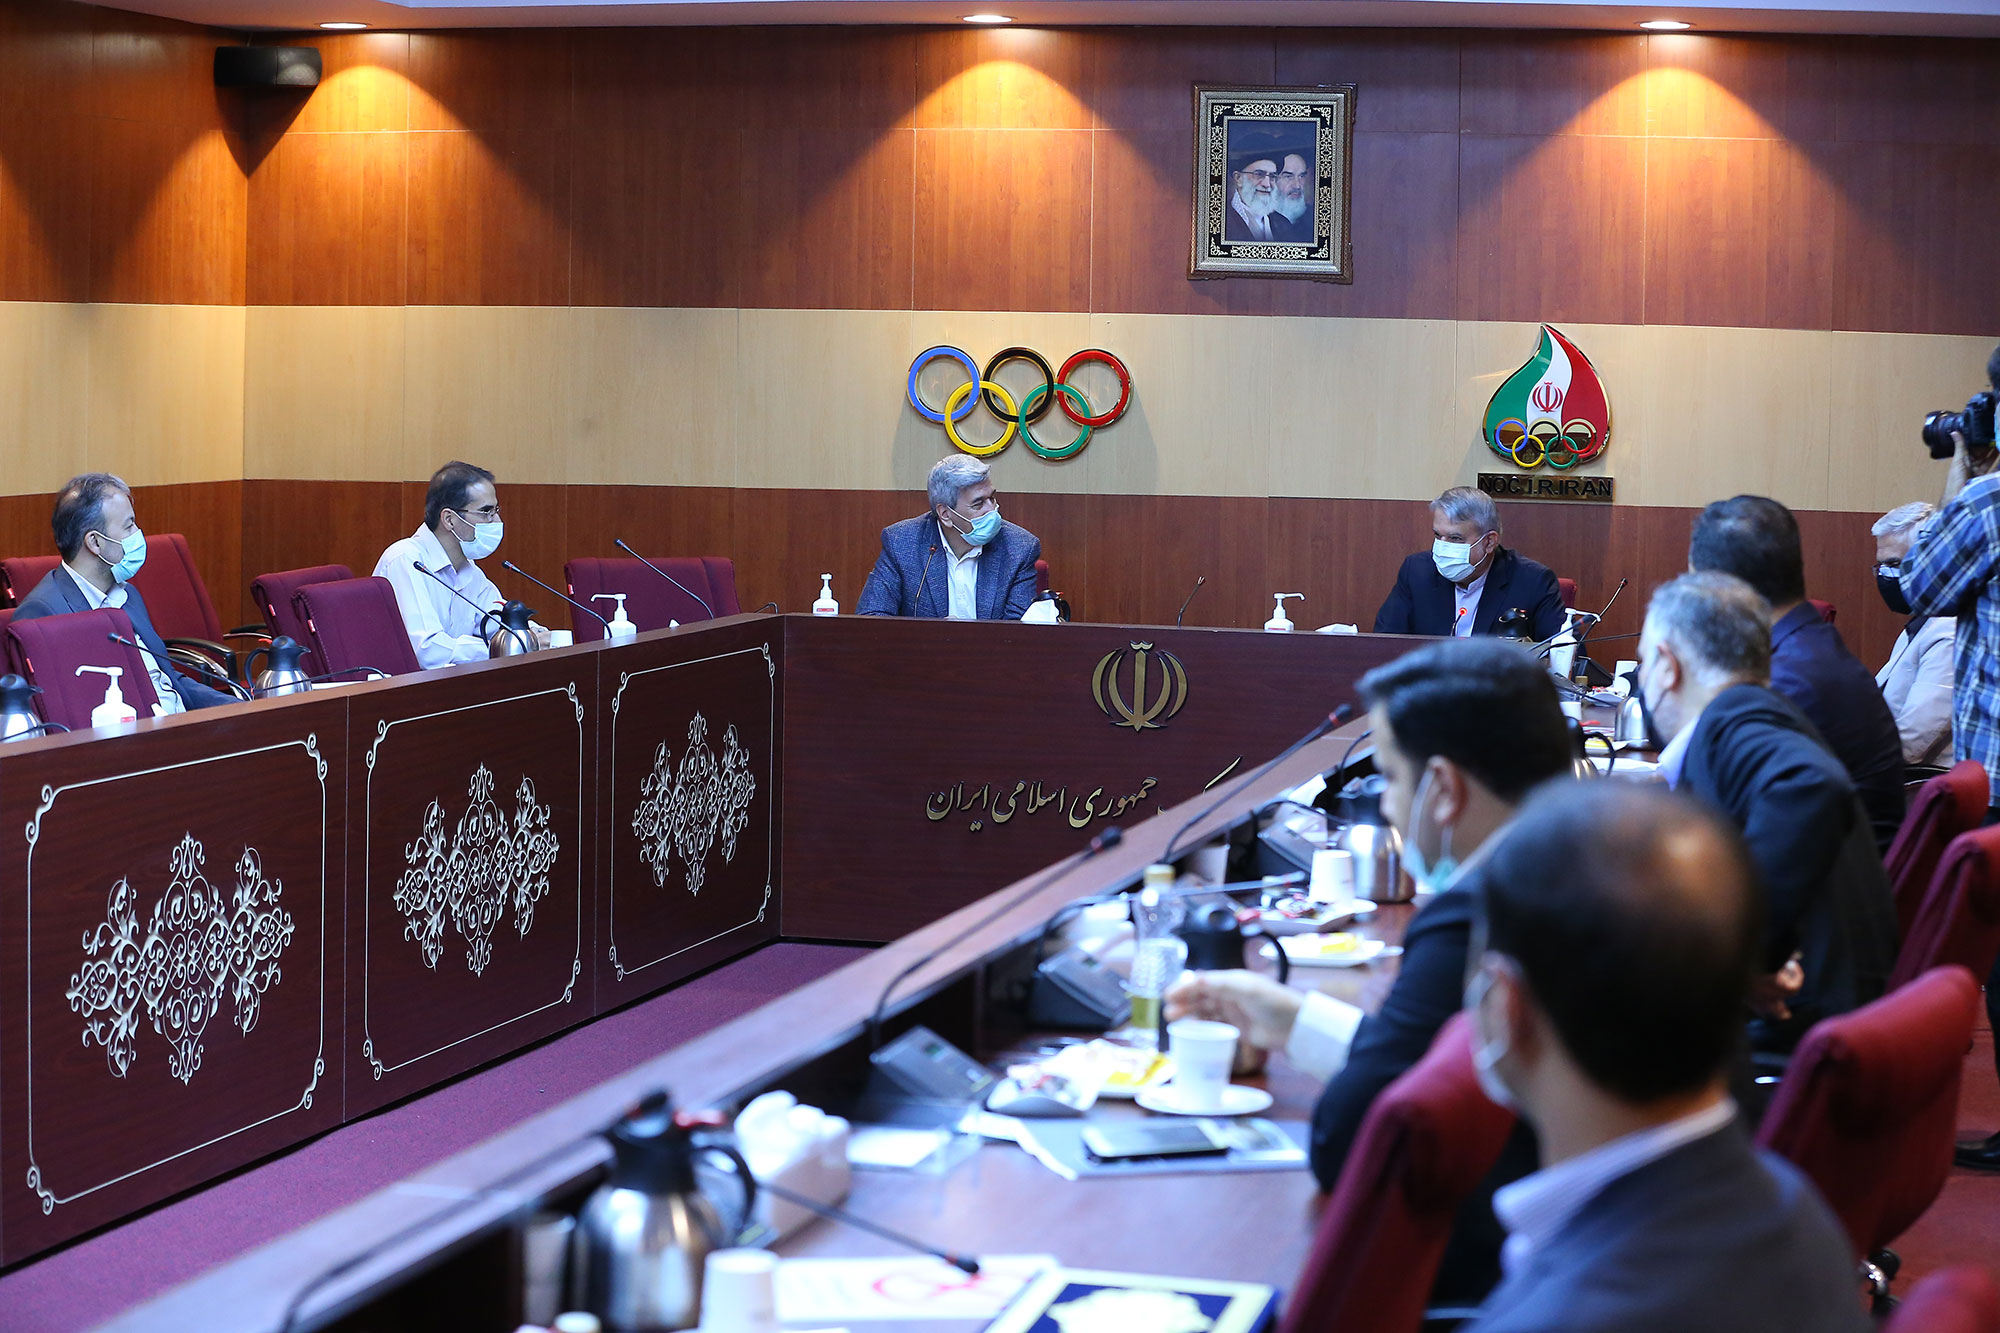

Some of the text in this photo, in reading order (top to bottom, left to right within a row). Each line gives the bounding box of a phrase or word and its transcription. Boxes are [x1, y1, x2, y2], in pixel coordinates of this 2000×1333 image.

[1479, 475, 1521, 493] NOC
[926, 780, 991, 832] ایران
[991, 779, 1067, 824] اسلامی
